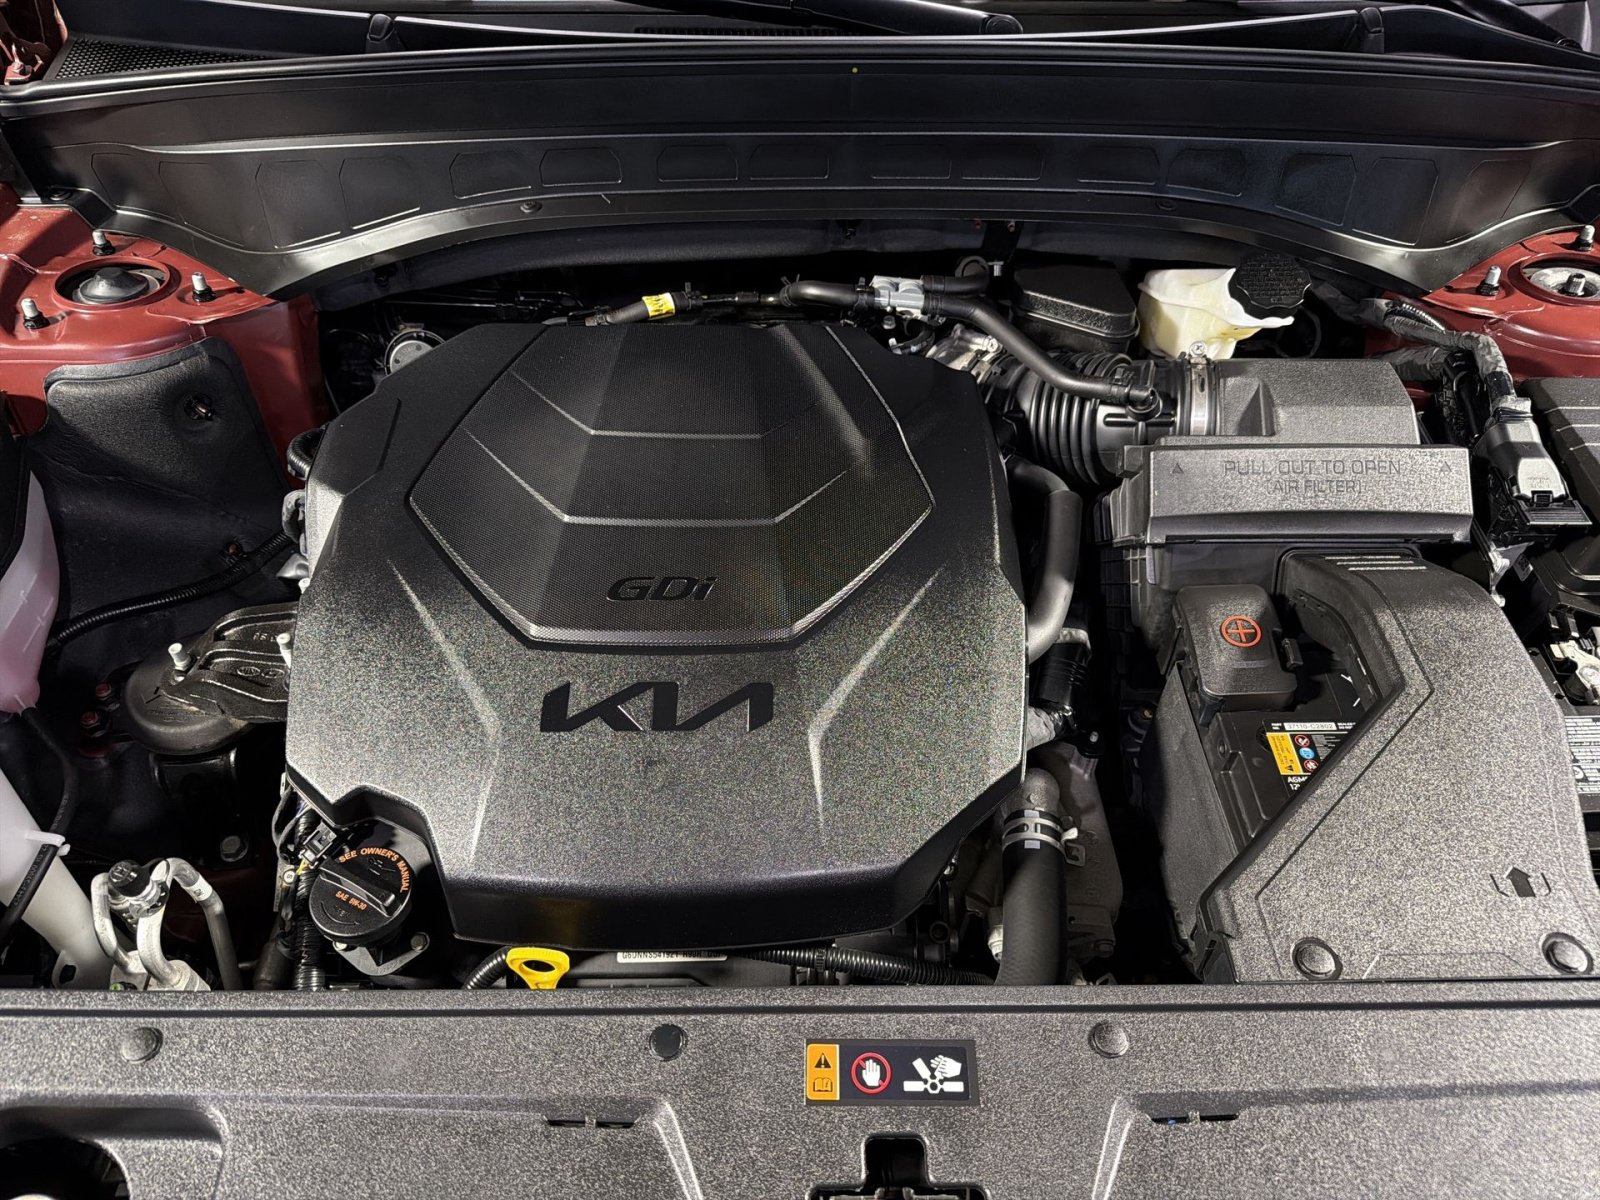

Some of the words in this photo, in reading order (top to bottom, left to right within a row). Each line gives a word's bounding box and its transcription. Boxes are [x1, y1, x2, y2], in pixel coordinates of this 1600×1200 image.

[1224, 460, 1272, 476] PULL
[1277, 460, 1317, 476] OUT
[1324, 460, 1348, 476] TO
[1352, 460, 1402, 476] OPEN
[606, 576, 718, 601] GDi
[540, 681, 773, 732] KIA
[338, 850, 358, 863] SEE
[360, 847, 400, 862] OWNER'S
[396, 859, 410, 894] MANUAL
[335, 890, 350, 903] SAE
